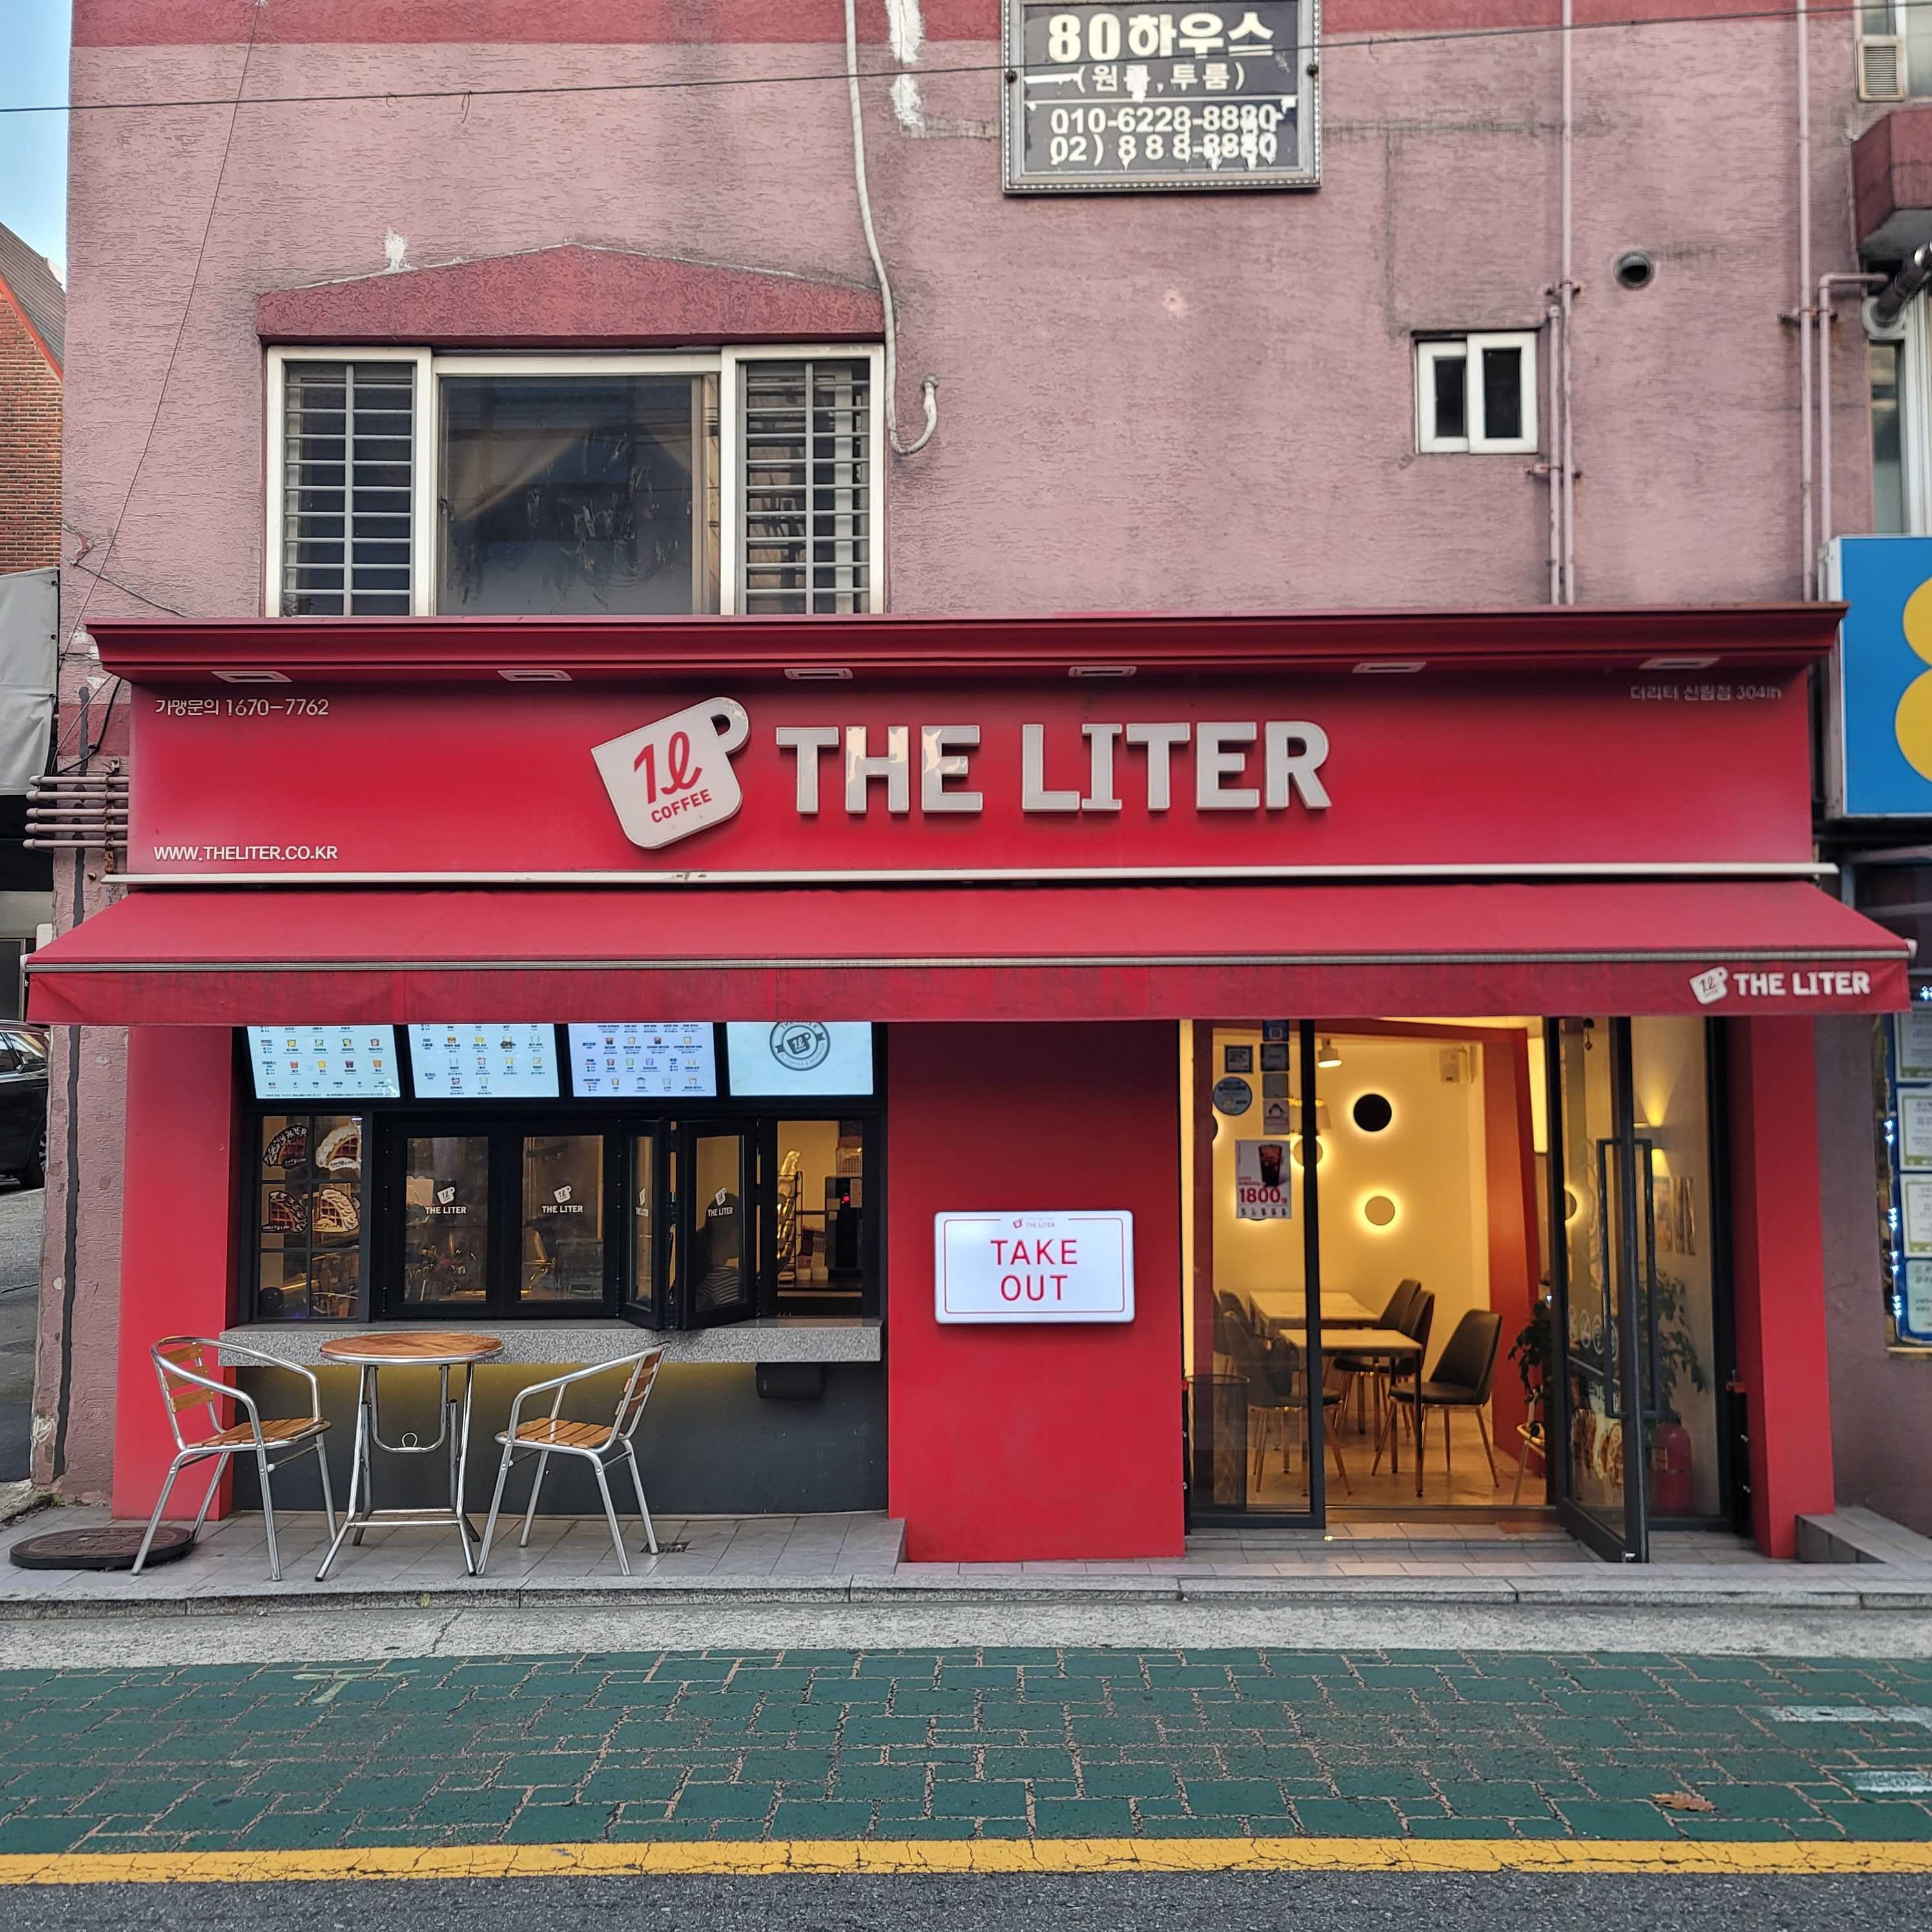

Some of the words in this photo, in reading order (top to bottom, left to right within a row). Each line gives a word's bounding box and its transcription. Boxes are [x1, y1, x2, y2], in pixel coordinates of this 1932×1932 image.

[1048, 12, 1275, 63] 80하우스
[1050, 104, 1277, 134] 010-6228-8880
[155, 699, 220, 715] 가맹문의
[225, 698, 330, 716] 1670-7762
[775, 723, 983, 815] THE
[1021, 720, 1333, 813] LITER
[651, 788, 712, 823] COFFEE
[154, 845, 338, 861] WWW.THELITER.CO.KR
[1732, 972, 1787, 996] THE
[1792, 971, 1871, 996] LITER
[1240, 1187, 1280, 1203] 1800
[425, 1206, 441, 1215] THE
[443, 1206, 467, 1215] LITER
[560, 1205, 583, 1213] LITER
[708, 1209, 718, 1217] THE
[991, 1239, 1078, 1265] TAKE
[1001, 1274, 1068, 1301] OUT
